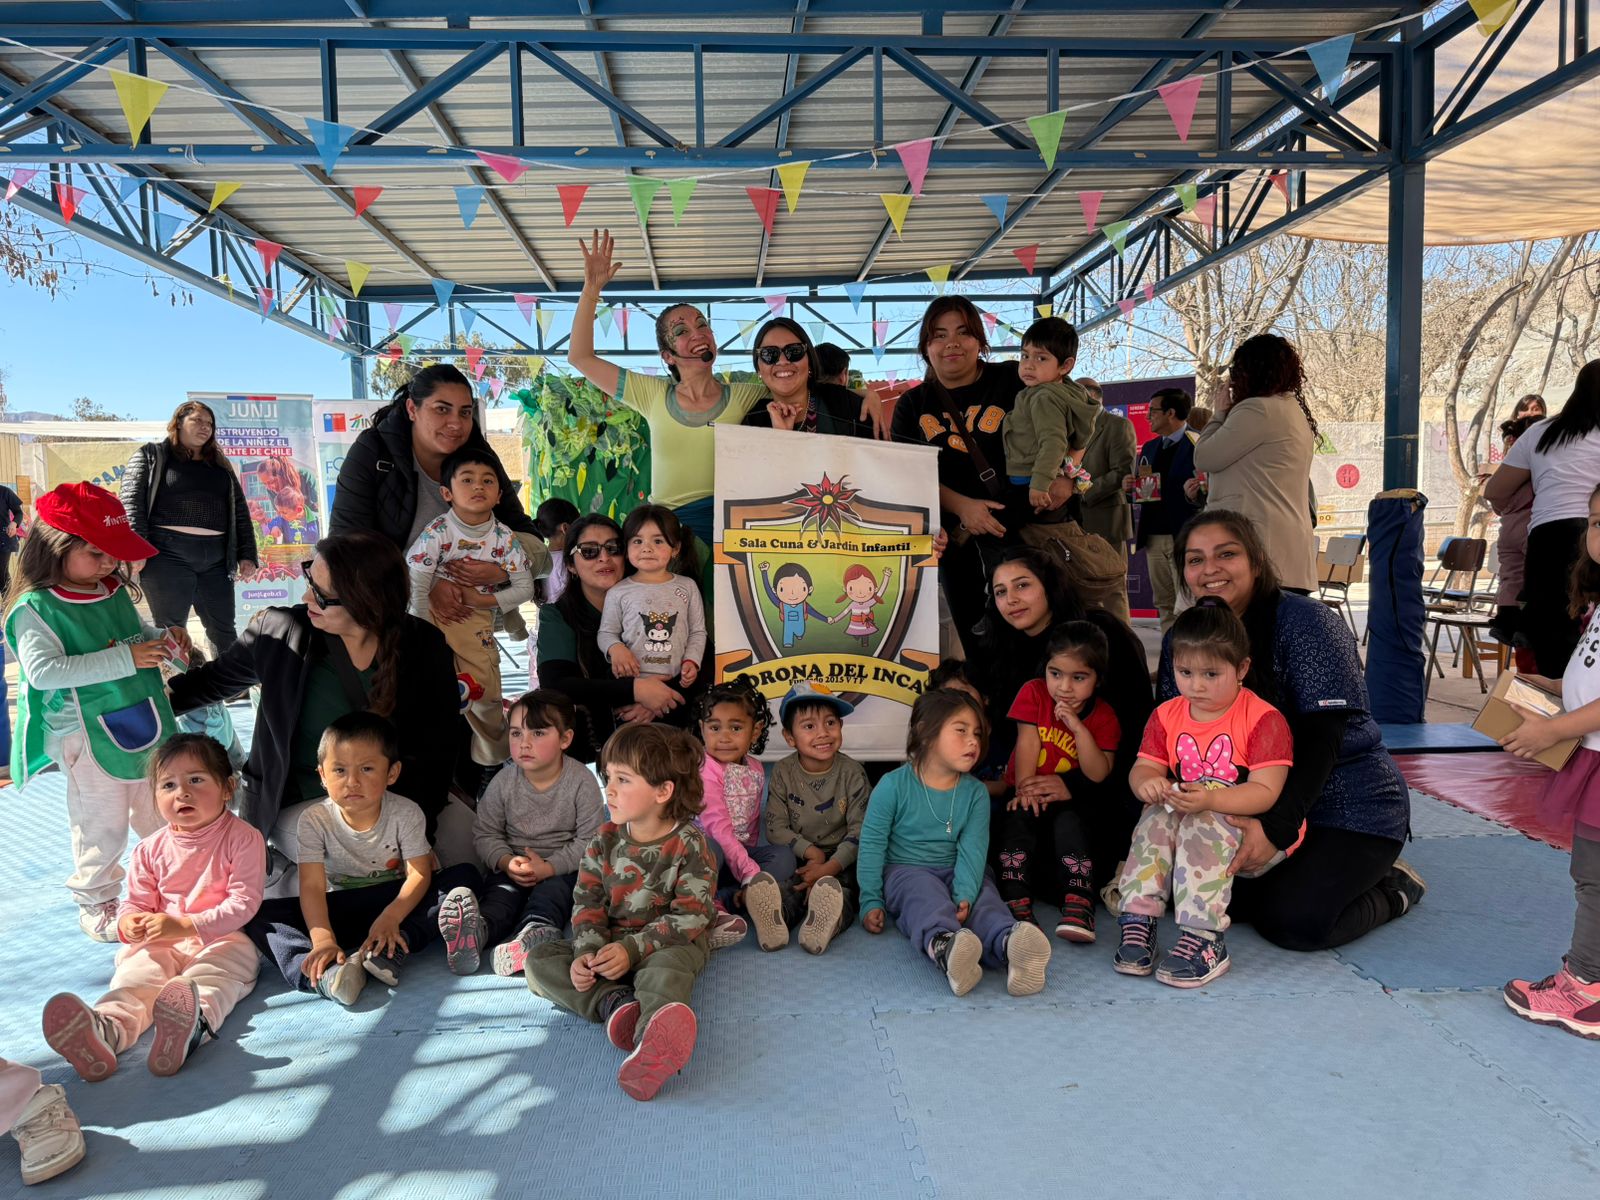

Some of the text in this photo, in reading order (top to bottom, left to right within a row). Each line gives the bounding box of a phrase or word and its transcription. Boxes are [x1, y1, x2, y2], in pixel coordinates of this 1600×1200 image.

[228, 402, 278, 418] JUNJI
[232, 438, 244, 446] LA
[246, 436, 275, 446] NIÑEZ
[249, 448, 262, 456] DE
[264, 448, 291, 456] CHILE
[739, 537, 767, 549] Sala
[770, 538, 804, 549] Cuna
[807, 539, 819, 549] &
[862, 541, 911, 552] Infantil
[747, 663, 923, 694] ORONA DEL INCA
[825, 676, 844, 684] 2015
[1002, 871, 1025, 881] SILK
